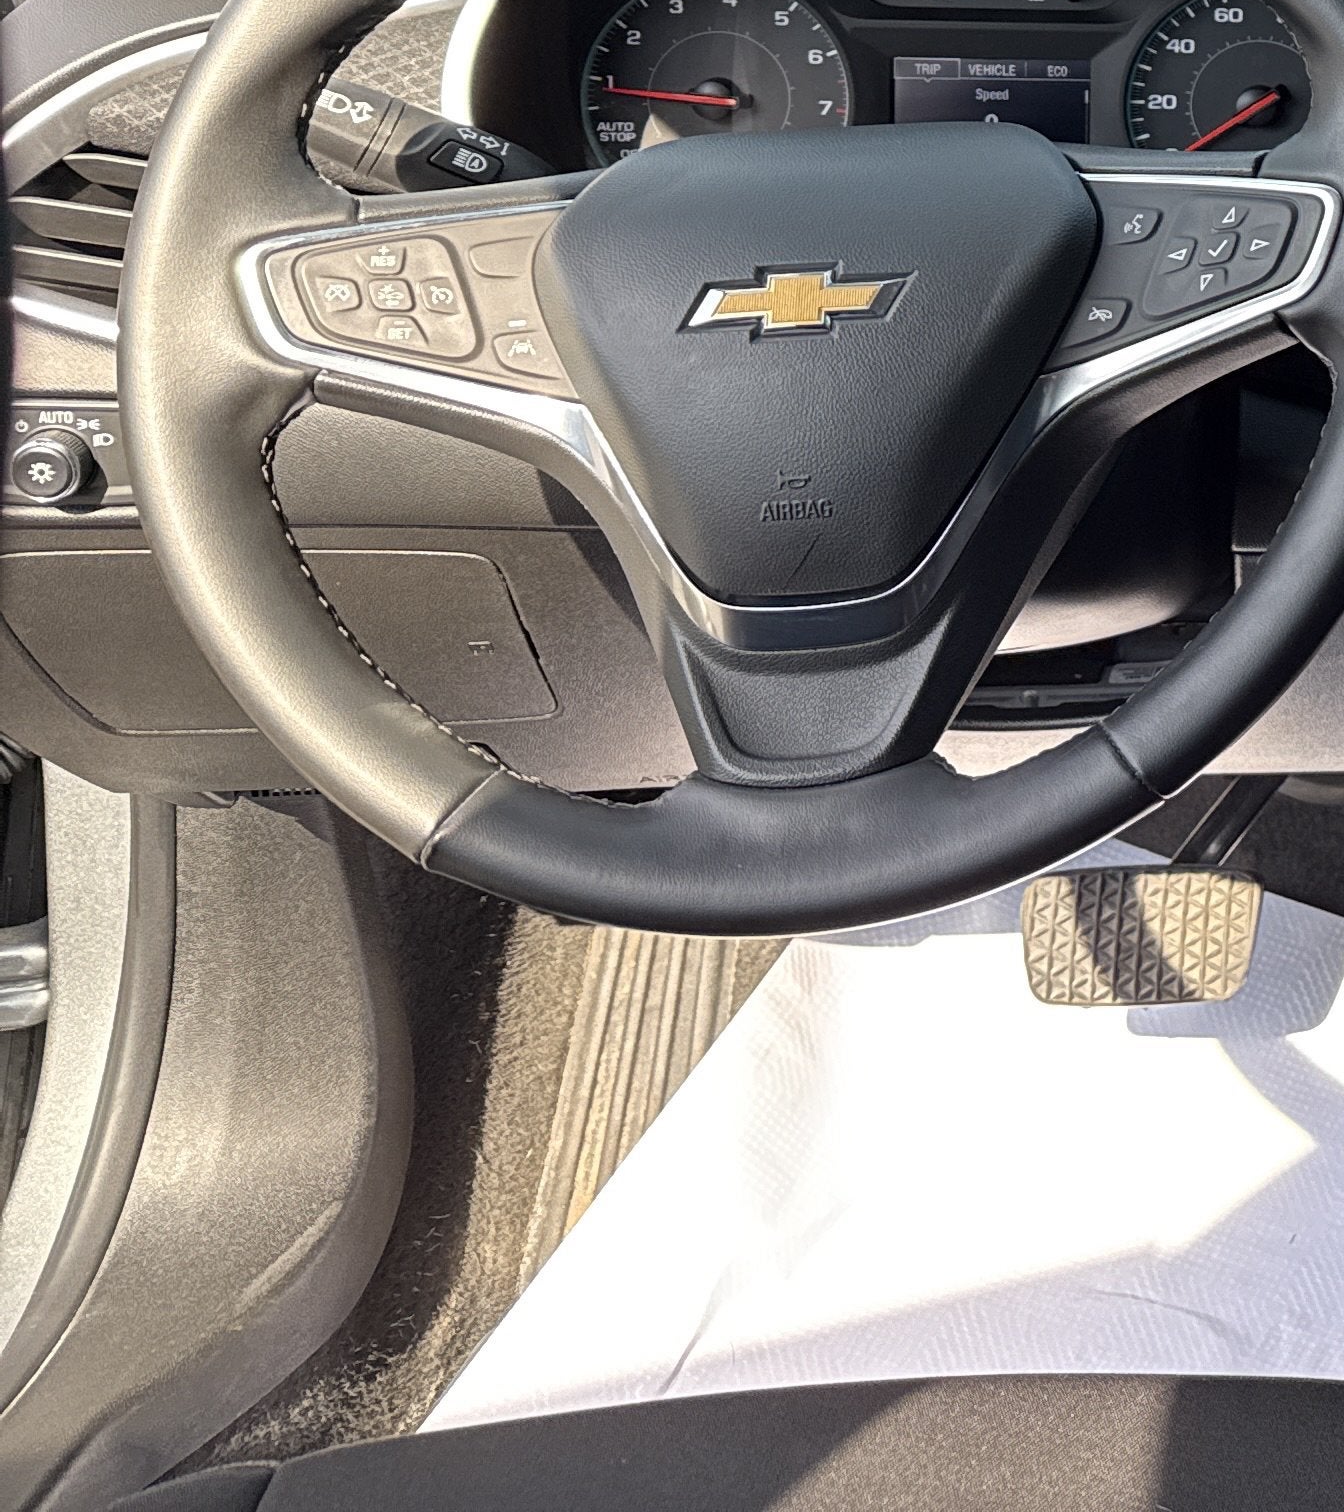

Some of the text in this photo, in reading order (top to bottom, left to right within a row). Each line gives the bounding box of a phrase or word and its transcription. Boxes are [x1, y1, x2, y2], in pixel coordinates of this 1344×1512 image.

[669, 0, 684, 15] 3
[774, 11, 790, 26] 5
[1213, 8, 1244, 23] 60
[627, 30, 642, 45] 2
[1166, 38, 1196, 54] 40
[808, 49, 824, 65] 6
[914, 63, 942, 76] TRIP
[968, 63, 1017, 77] VEHICLE
[1047, 65, 1069, 78] ECO
[605, 75, 614, 88] 1
[975, 88, 1010, 102] Speed
[1147, 94, 1178, 110] 20
[818, 100, 834, 116] 7
[596, 121, 635, 131] AUTO
[600, 132, 637, 142] STOP
[370, 255, 396, 267] RES
[387, 327, 412, 340] SET
[38, 410, 74, 424] AUTO
[760, 498, 834, 522] AIRBAG
